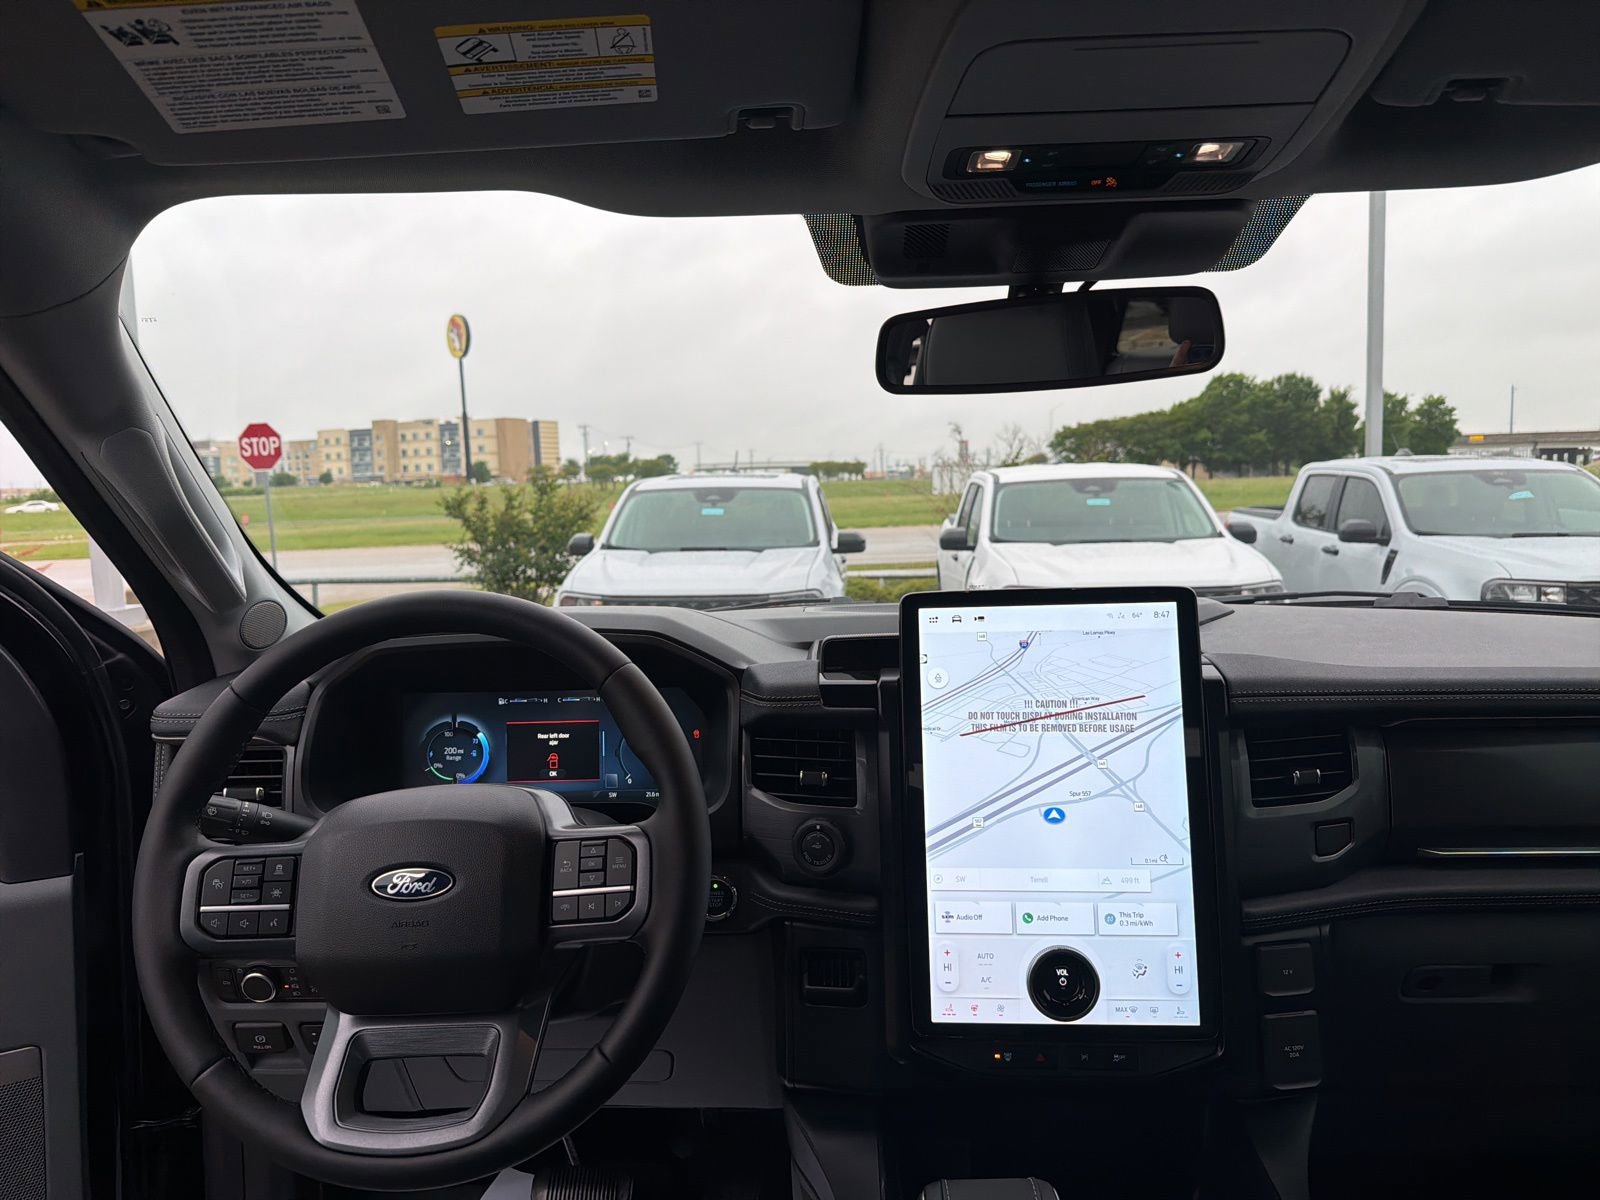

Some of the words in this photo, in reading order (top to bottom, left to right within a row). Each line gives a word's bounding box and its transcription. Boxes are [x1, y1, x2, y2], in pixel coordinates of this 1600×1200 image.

[240, 436, 280, 458] STOP
[1153, 610, 1170, 619] 8:47
[1024, 699, 1033, 709] !!!
[1035, 699, 1067, 709] CAUTION
[968, 711, 978, 720] DO
[980, 711, 995, 720] NOT
[996, 711, 1020, 720] TOUCH
[1022, 711, 1052, 720] DISPLAY
[1054, 711, 1083, 721] DURING
[1085, 711, 1138, 721] INSTALLATION
[971, 723, 987, 732] THIS
[1008, 723, 1017, 732] IS
[1018, 723, 1028, 732] TO
[1029, 723, 1040, 732] BE
[1041, 723, 1077, 733] REMOVED
[1079, 723, 1108, 733] BEFORE
[1109, 723, 1135, 733] USAGE
[444, 747, 458, 755] 200
[1069, 790, 1081, 798] Spur
[386, 872, 438, 895] Ford
[955, 875, 966, 883] SW
[1037, 914, 1049, 922] Add
[1050, 914, 1069, 922] Phone
[1119, 911, 1132, 919] This
[1133, 911, 1145, 920] Trip
[1130, 919, 1154, 927] mi/kWh
[977, 952, 995, 960] AUTO
[943, 963, 953, 972] HI
[1055, 968, 1069, 976] VOL
[1174, 965, 1184, 975] HI
[980, 976, 993, 984] A/C
